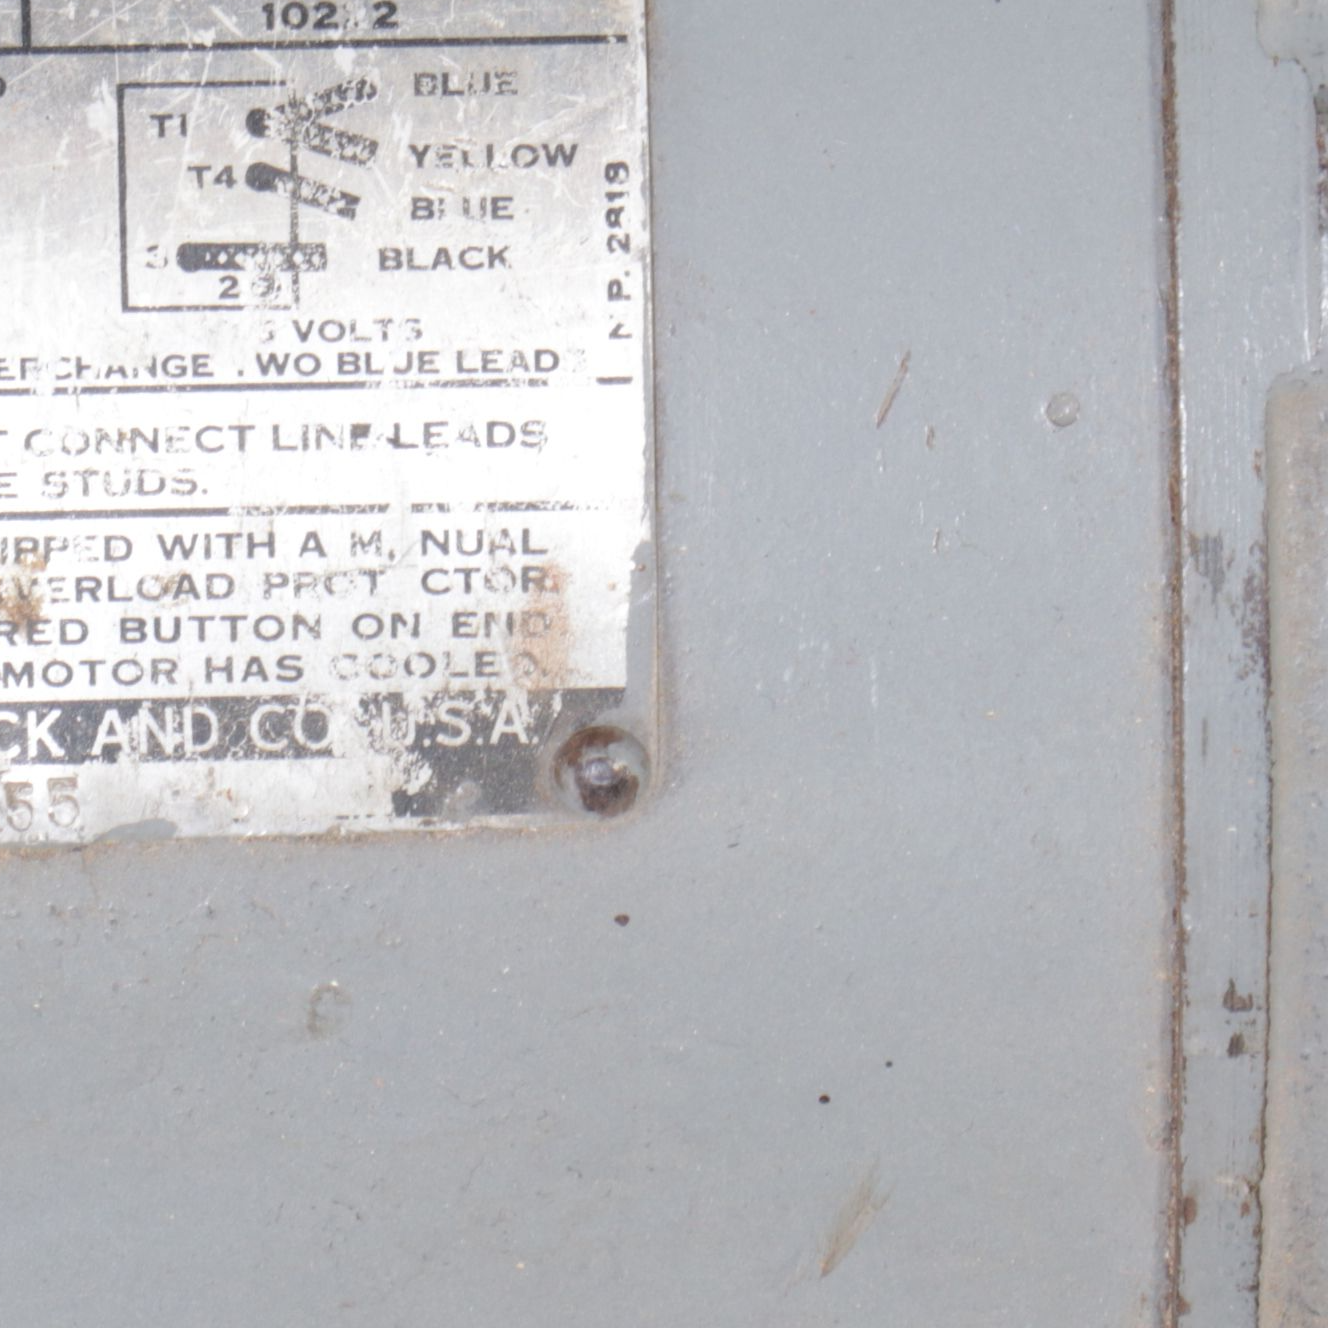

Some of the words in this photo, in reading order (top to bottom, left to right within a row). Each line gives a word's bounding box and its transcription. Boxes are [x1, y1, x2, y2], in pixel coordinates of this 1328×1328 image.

[262, 0, 399, 31] 1022
[414, 71, 518, 97] BLUE
[150, 114, 187, 138] T1
[409, 143, 578, 169] YELLOW
[188, 166, 236, 190] T4
[378, 246, 512, 271] BLACK
[293, 318, 423, 344] VOLTS
[239, 351, 321, 378] WO
[456, 349, 586, 374] LEAD
[24, 423, 254, 457] CONNECT
[387, 420, 548, 453] LEADS
[41, 469, 209, 499] STUDS.
[156, 532, 275, 562] WITH
[299, 531, 328, 559] A
[350, 528, 549, 561] MNUAL
[263, 566, 559, 599] PROTCTOR
[120, 613, 322, 645] BUTTON
[352, 612, 421, 640] ON
[451, 609, 552, 639] END
[2, 657, 178, 689] MOTOR
[205, 653, 304, 683] HAS
[92, 703, 220, 755] AND
